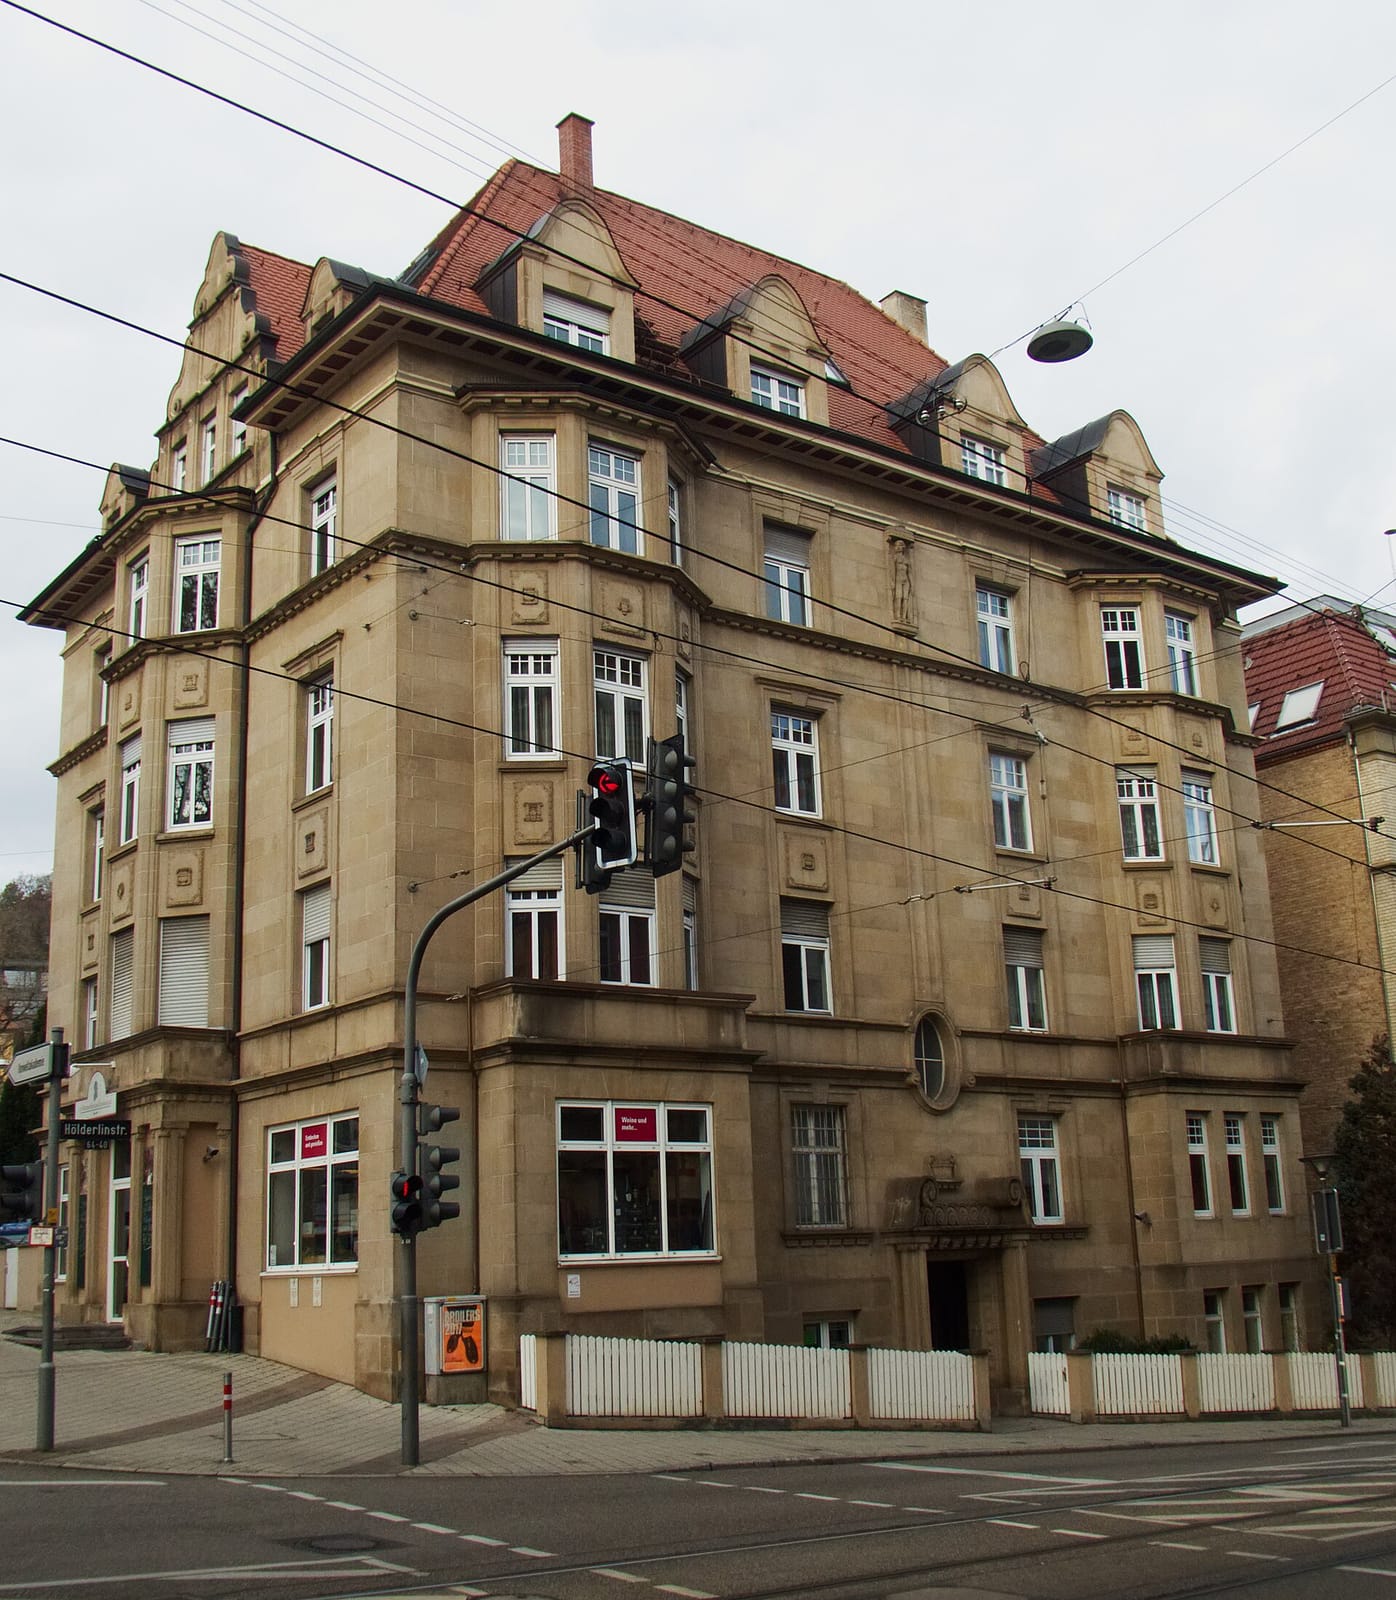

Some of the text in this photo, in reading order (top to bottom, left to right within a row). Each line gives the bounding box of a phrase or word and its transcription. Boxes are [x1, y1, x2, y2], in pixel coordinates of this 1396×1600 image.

[64, 1123, 128, 1136] Hölderlinstr.
[444, 1309, 481, 1323] BROILERS
[444, 1322, 463, 1336] 2017
